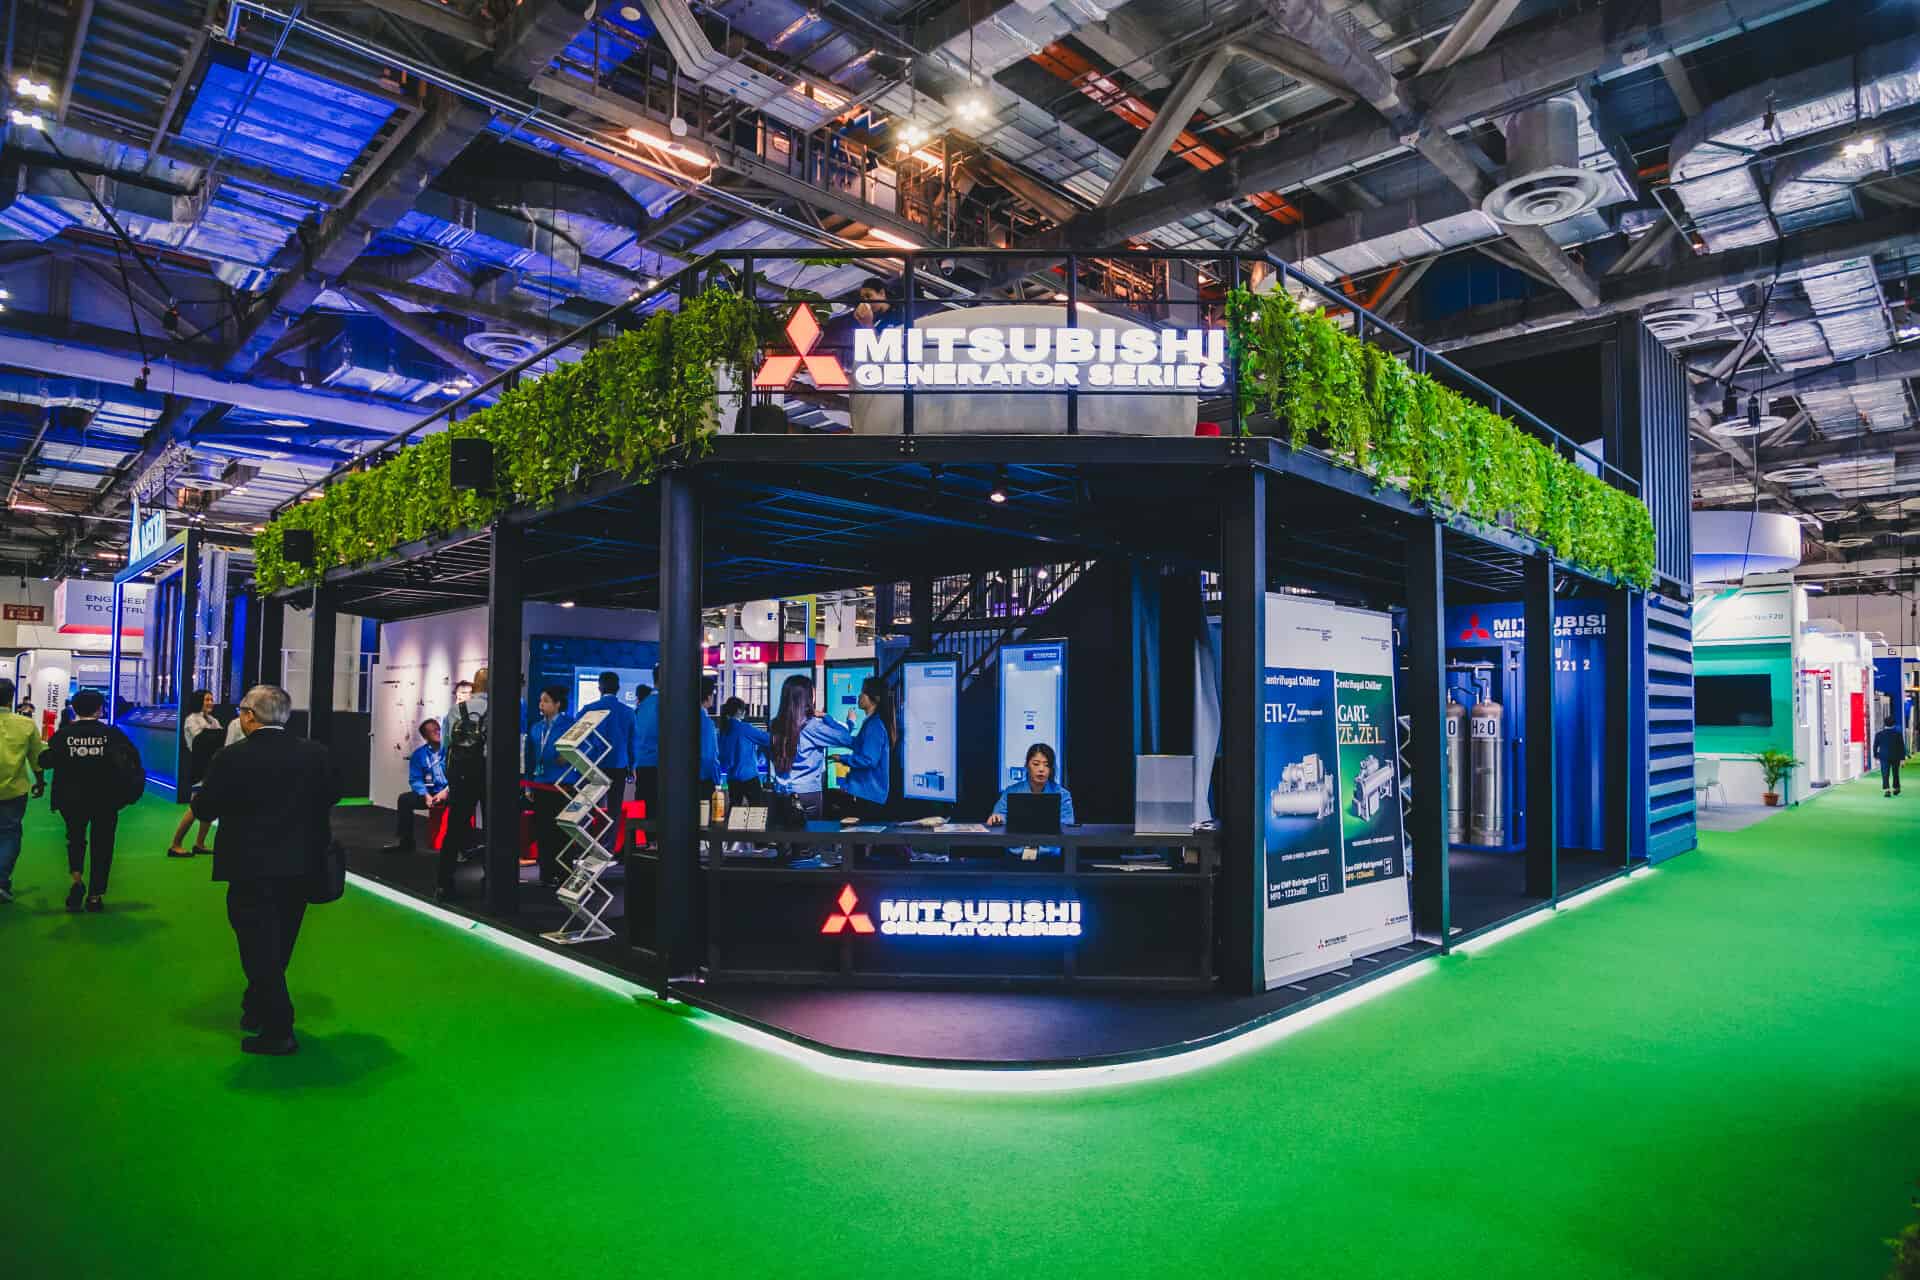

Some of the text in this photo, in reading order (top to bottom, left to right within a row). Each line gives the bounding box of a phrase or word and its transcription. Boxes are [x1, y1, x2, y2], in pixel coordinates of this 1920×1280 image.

[854, 328, 1225, 364] MITSUBISHI
[855, 363, 1225, 387] GENERATOR SERIES
[1299, 676, 1321, 687] Chiller
[1472, 720, 1496, 735] H2O
[880, 900, 1082, 922] MITSUBISHI
[881, 921, 1082, 936] GENERATOR SERIES
